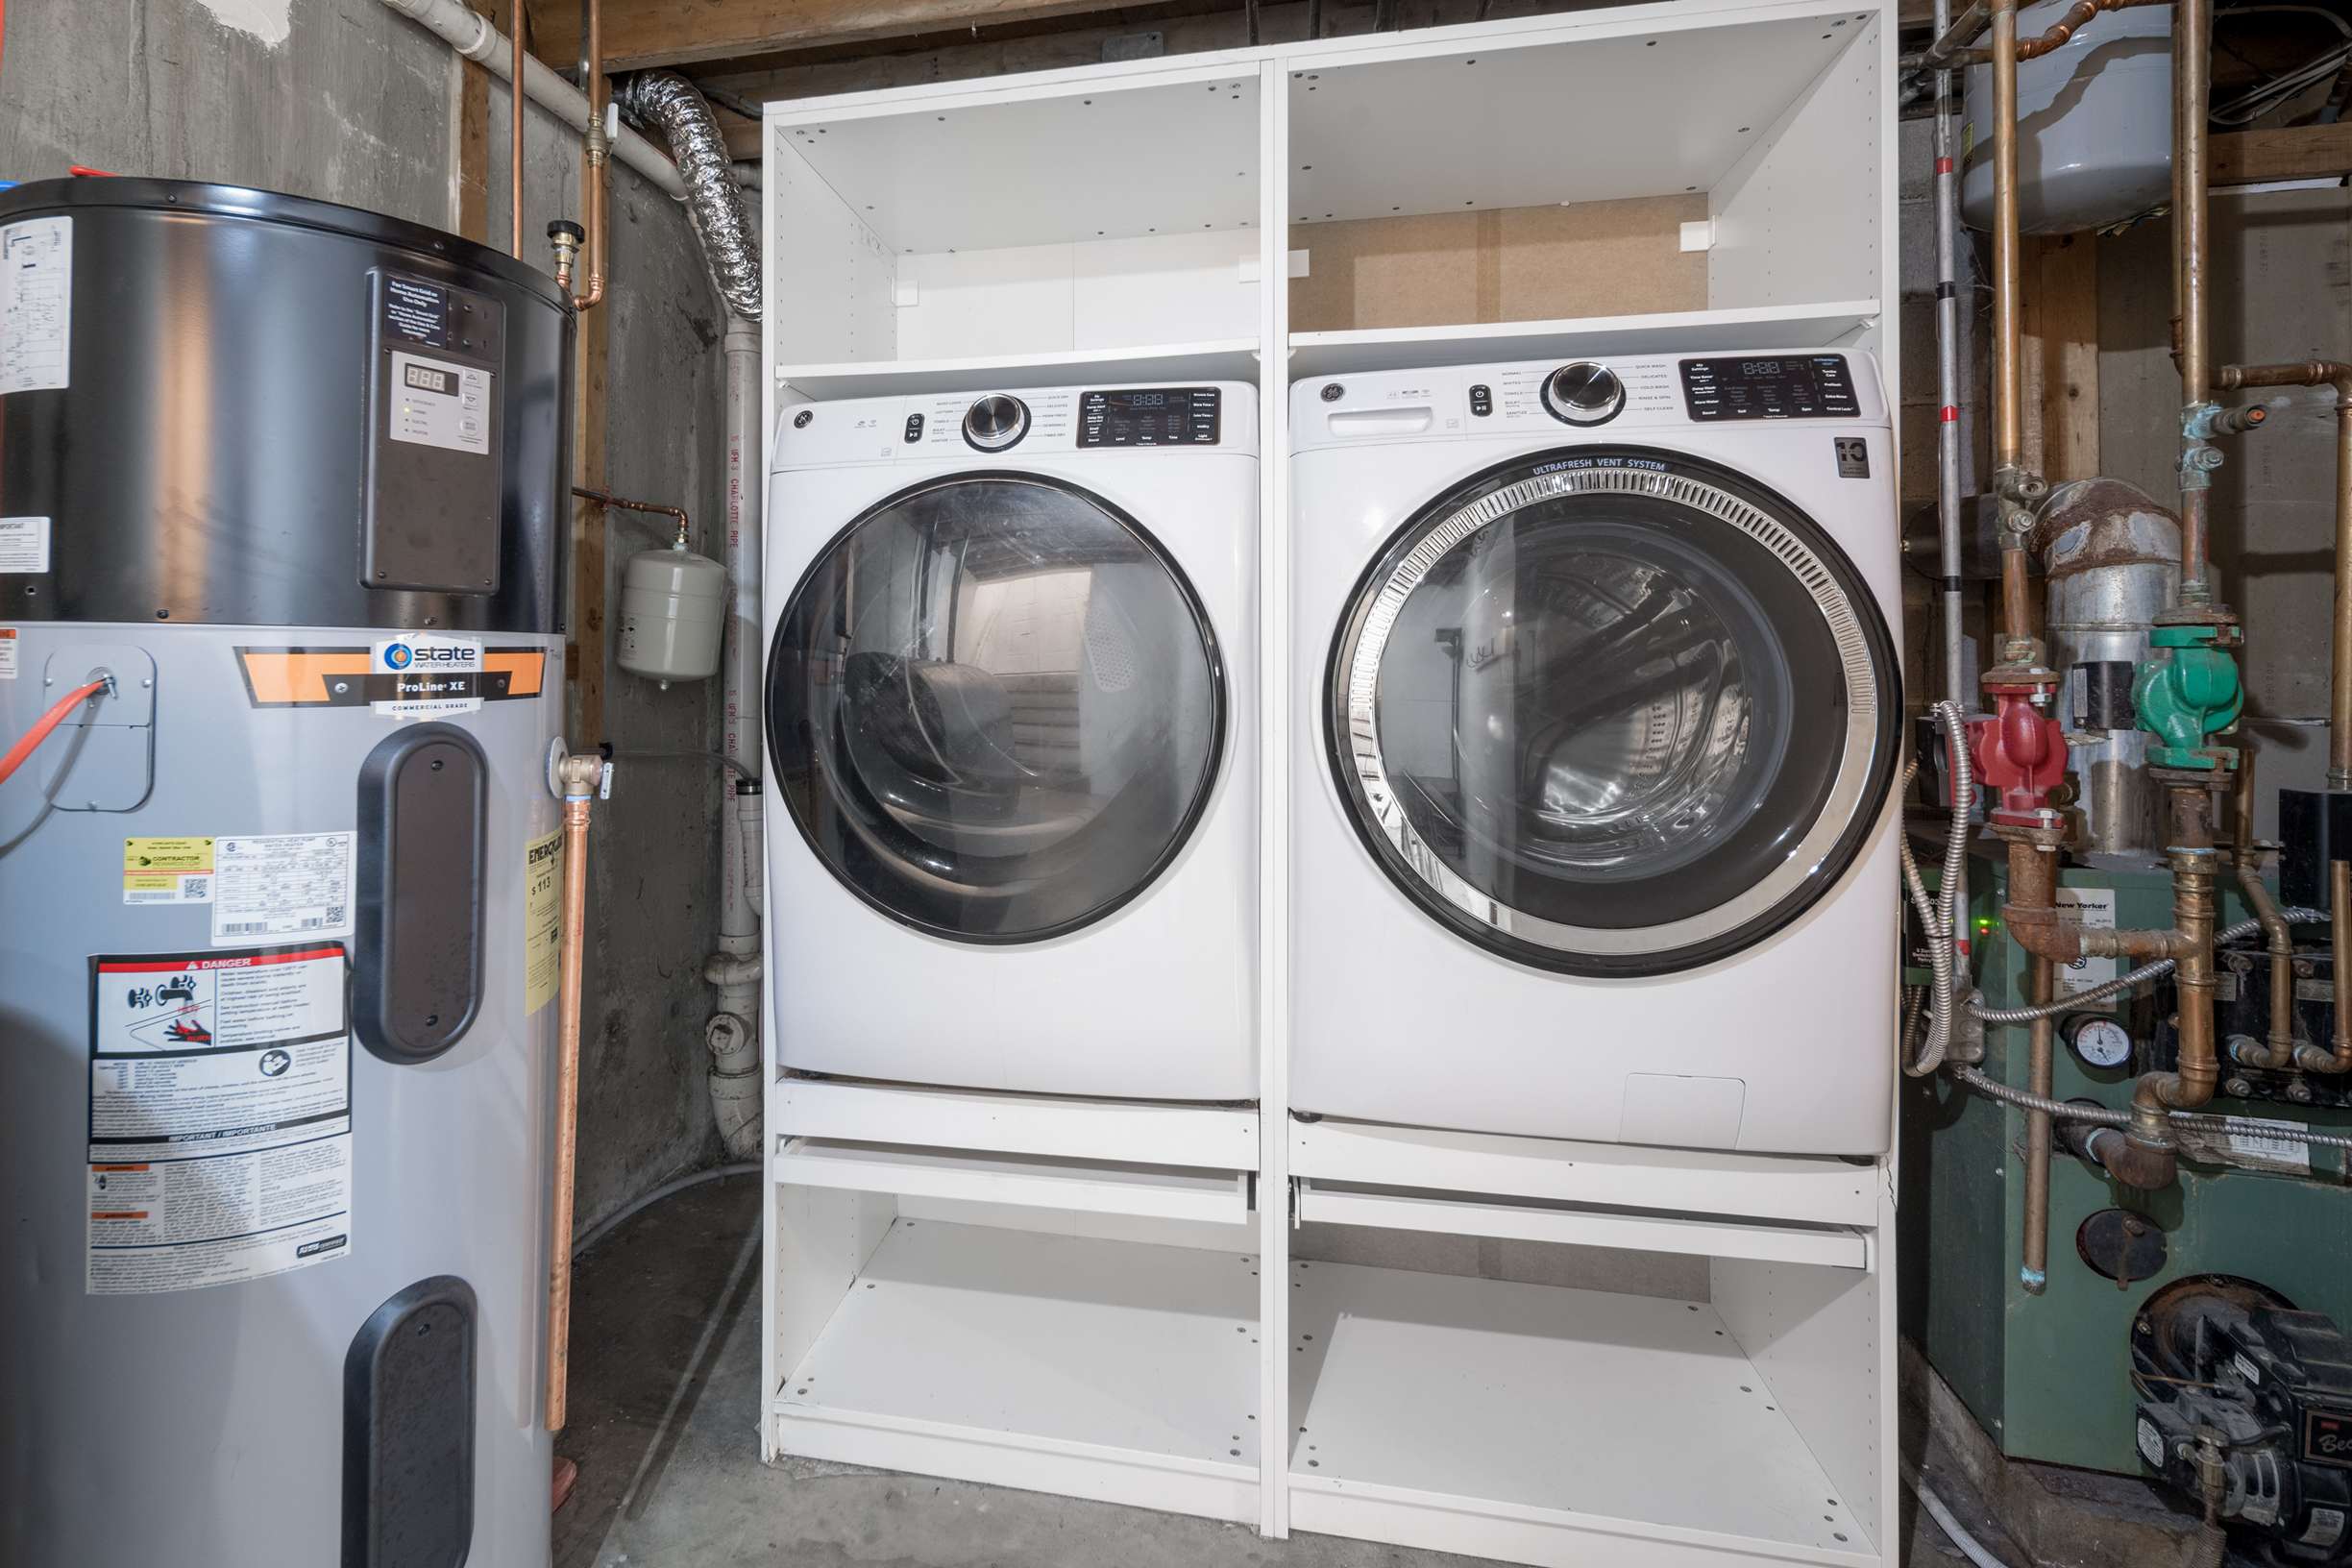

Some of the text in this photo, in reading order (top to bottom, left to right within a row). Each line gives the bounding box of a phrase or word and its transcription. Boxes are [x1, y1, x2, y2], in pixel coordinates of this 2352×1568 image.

[1532, 458, 1665, 476] ULTRAFRESH VENT SYSTEM
[415, 647, 476, 661] state
[450, 681, 465, 691] XE
[202, 959, 252, 969] DANGER
